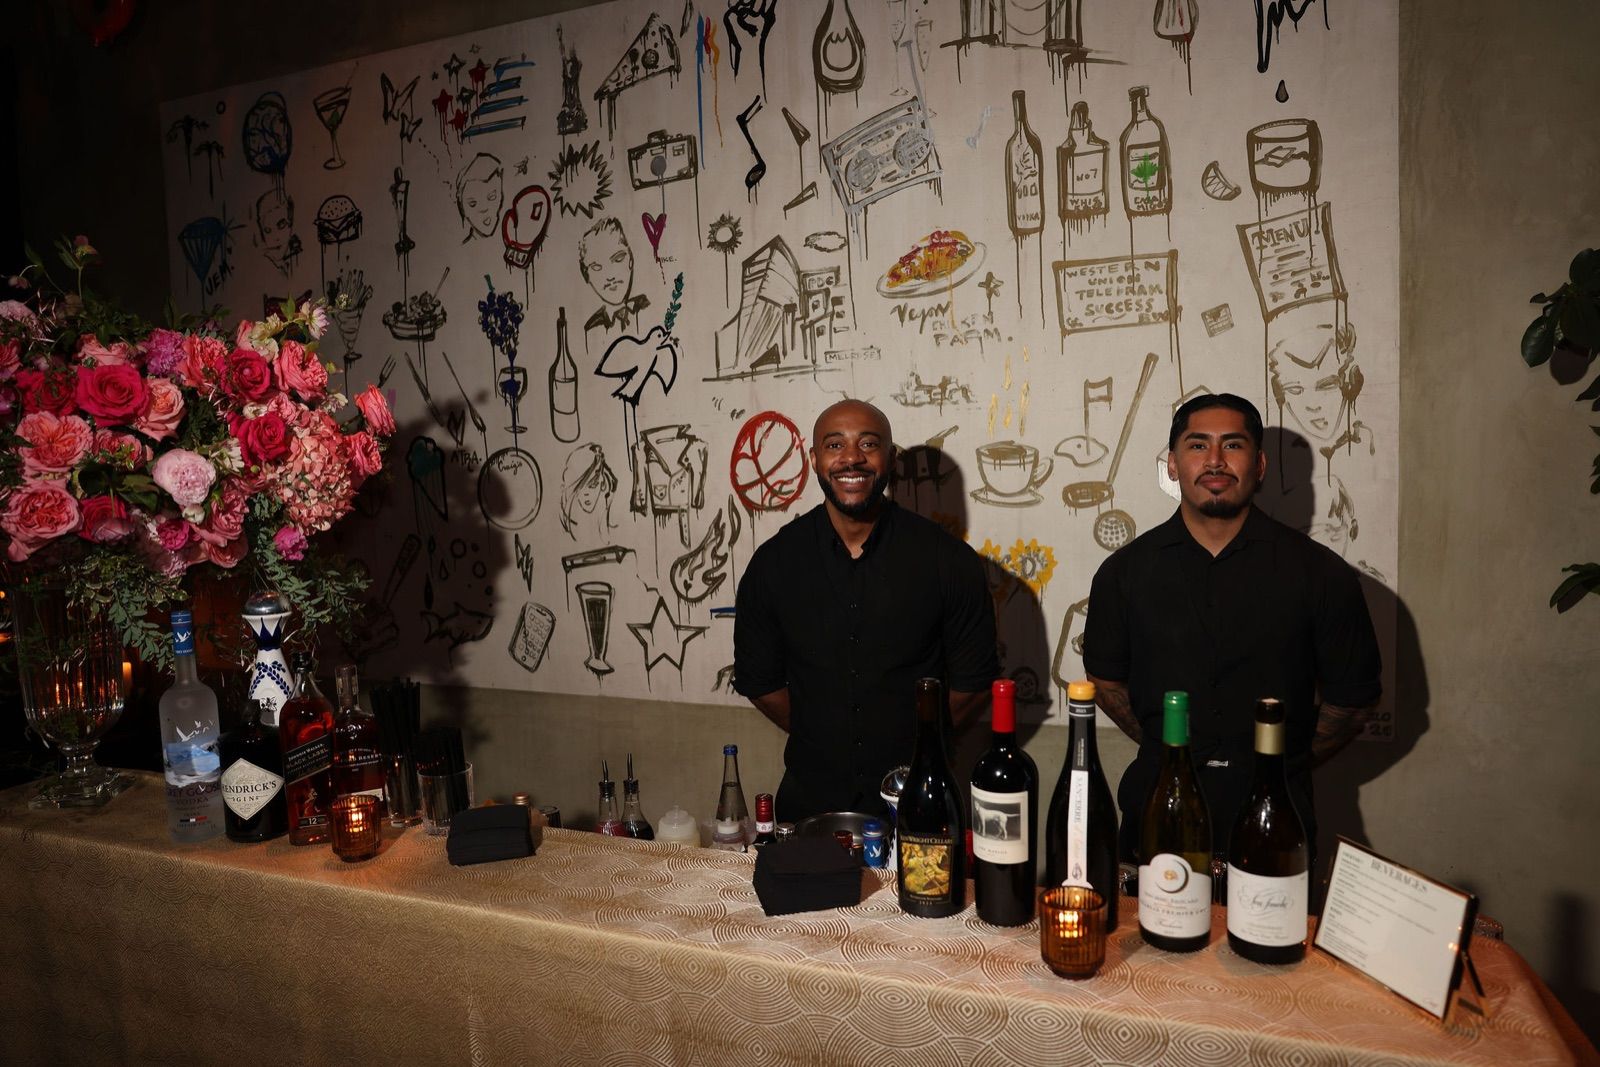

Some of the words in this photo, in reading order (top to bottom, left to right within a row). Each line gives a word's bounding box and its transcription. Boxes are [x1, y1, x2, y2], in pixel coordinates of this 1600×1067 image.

[1251, 217, 1310, 250] MENU
[1066, 260, 1160, 278] WESTERN
[1087, 273, 1141, 286] UNION
[1084, 298, 1155, 317] SUCCESS
[308, 817, 318, 826] 12
